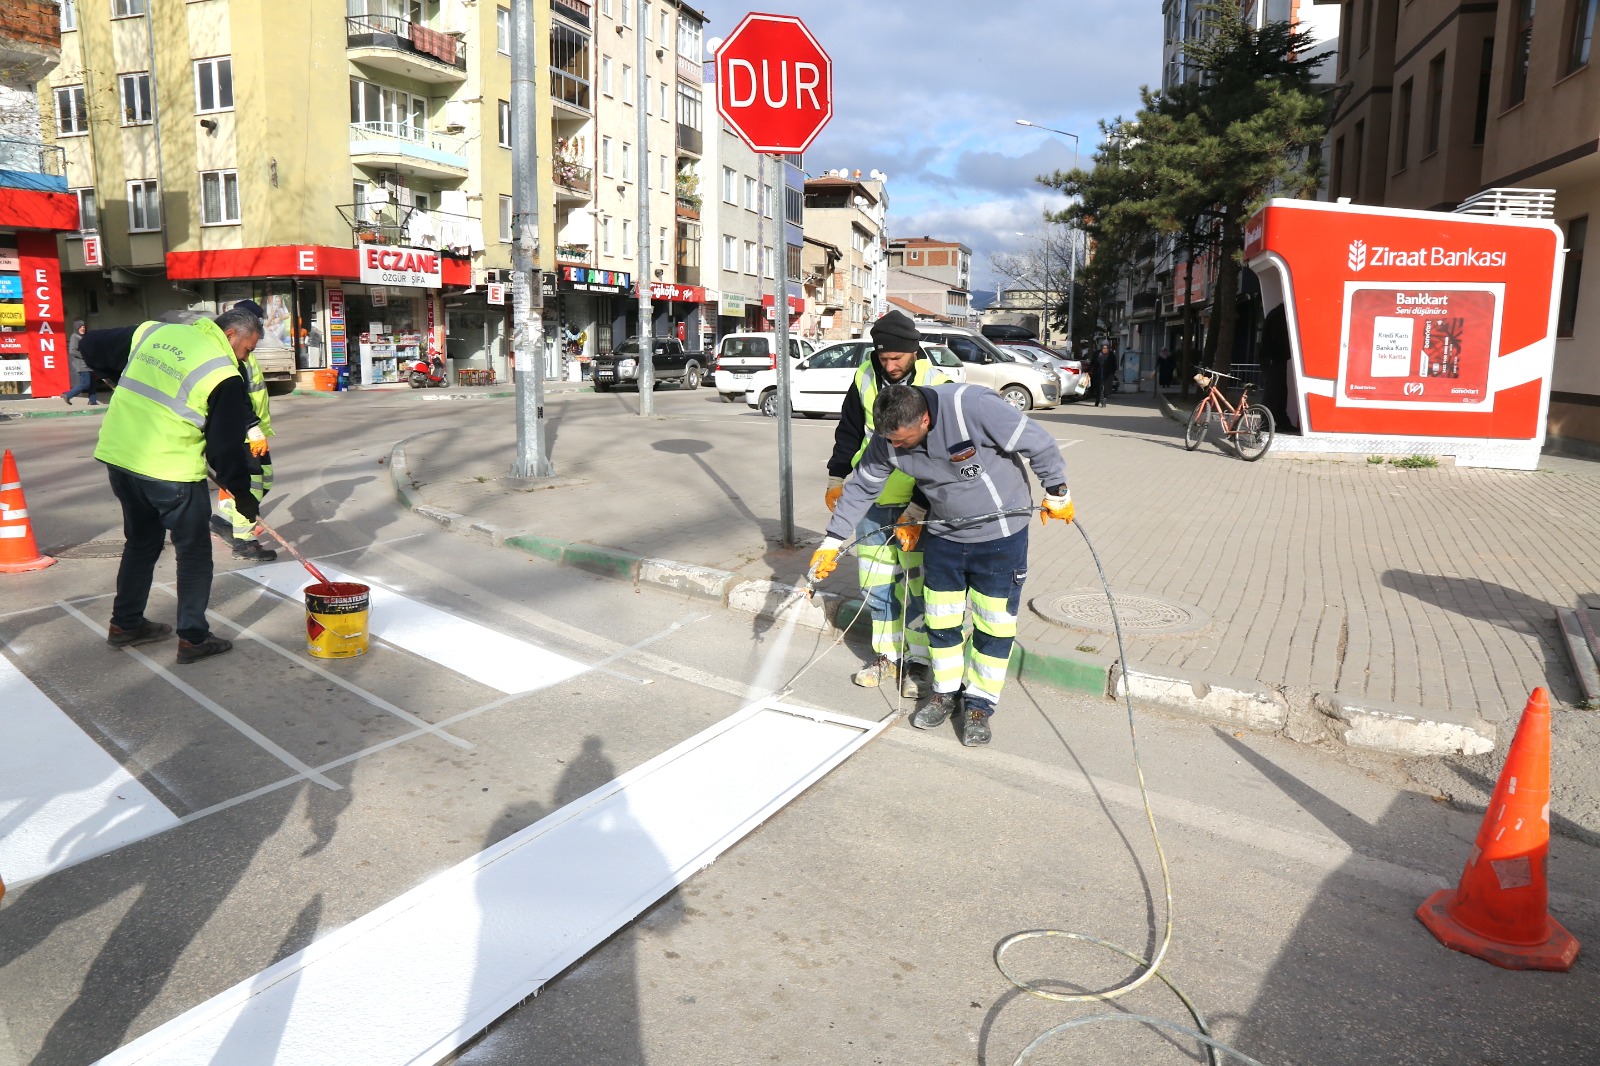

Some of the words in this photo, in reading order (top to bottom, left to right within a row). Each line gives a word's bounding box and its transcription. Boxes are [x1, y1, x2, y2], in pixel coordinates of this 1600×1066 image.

[728, 58, 821, 110] DUR
[86, 241, 97, 261] E
[298, 250, 315, 271] E
[366, 248, 440, 274] ECZANE
[1370, 246, 1428, 266] Ziraat
[1430, 246, 1506, 267] Bankası
[382, 272, 406, 283] ÖZGÜR
[411, 273, 425, 285] ŞİFA
[563, 266, 584, 282] ZEN
[588, 269, 629, 289] AMBALAJ
[491, 287, 500, 300] E
[1396, 293, 1448, 305] Bankkart
[35, 269, 55, 369] ECZANE
[1395, 306, 1411, 314] Seni
[1412, 307, 1442, 316] düşünür
[152, 343, 186, 362] BURSA
